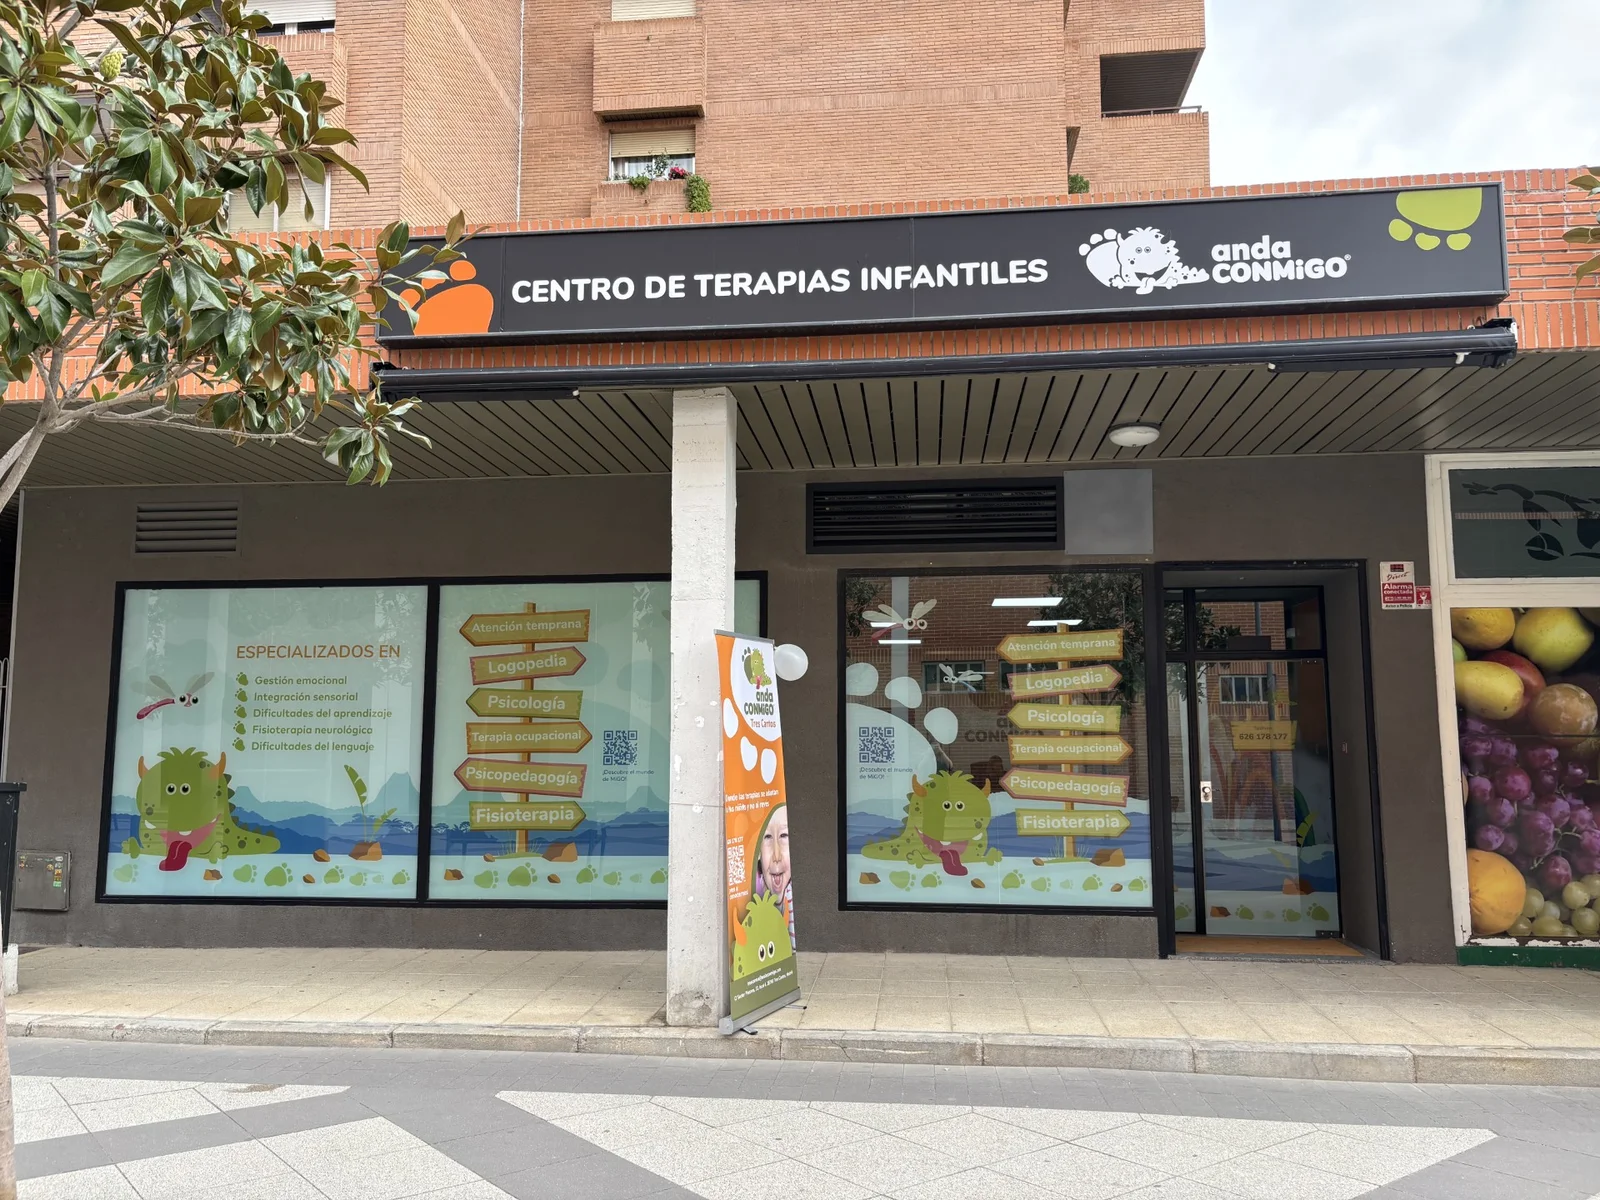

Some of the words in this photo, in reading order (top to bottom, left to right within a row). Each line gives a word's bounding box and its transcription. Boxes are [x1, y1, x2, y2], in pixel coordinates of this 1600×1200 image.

[1211, 235, 1291, 262] anda
[511, 276, 636, 304] CENTRO
[644, 274, 686, 301] DE
[694, 267, 852, 298] TERAPIAS
[860, 258, 1049, 292] INFANTILES
[471, 619, 523, 633] Atención
[526, 618, 582, 632] temprana
[236, 644, 374, 659] ESPECIALIZADOS
[379, 644, 401, 659] EN
[1006, 639, 1058, 652] Atención
[1060, 637, 1116, 651] temprana
[488, 654, 567, 674] Logopedia
[254, 675, 294, 685] Gestión
[296, 675, 348, 685] emocional
[1025, 671, 1104, 691] Logopedia
[253, 692, 311, 703] Integración
[313, 692, 359, 701] sensorial
[756, 688, 773, 702] anda
[487, 695, 566, 713] Psicología
[253, 708, 314, 718] Dificultades
[315, 708, 331, 718] del
[333, 708, 393, 720] aprendizaje
[1027, 709, 1105, 727] Psicología
[252, 724, 312, 736] Fisioterapia
[314, 724, 373, 736] neurológica
[471, 731, 513, 744] Terapia
[514, 730, 582, 743] ocupacional
[251, 741, 313, 751] Dificultades
[314, 741, 330, 751] del
[332, 741, 375, 753] lenguaje
[1015, 743, 1053, 756] Terapia
[1056, 742, 1123, 755] ocupacional
[465, 765, 578, 786] Psicopedagogía
[1010, 775, 1122, 796] Psicopedagogía
[475, 805, 575, 824] Fisioterapia
[1022, 814, 1120, 832] Fisioterapia
